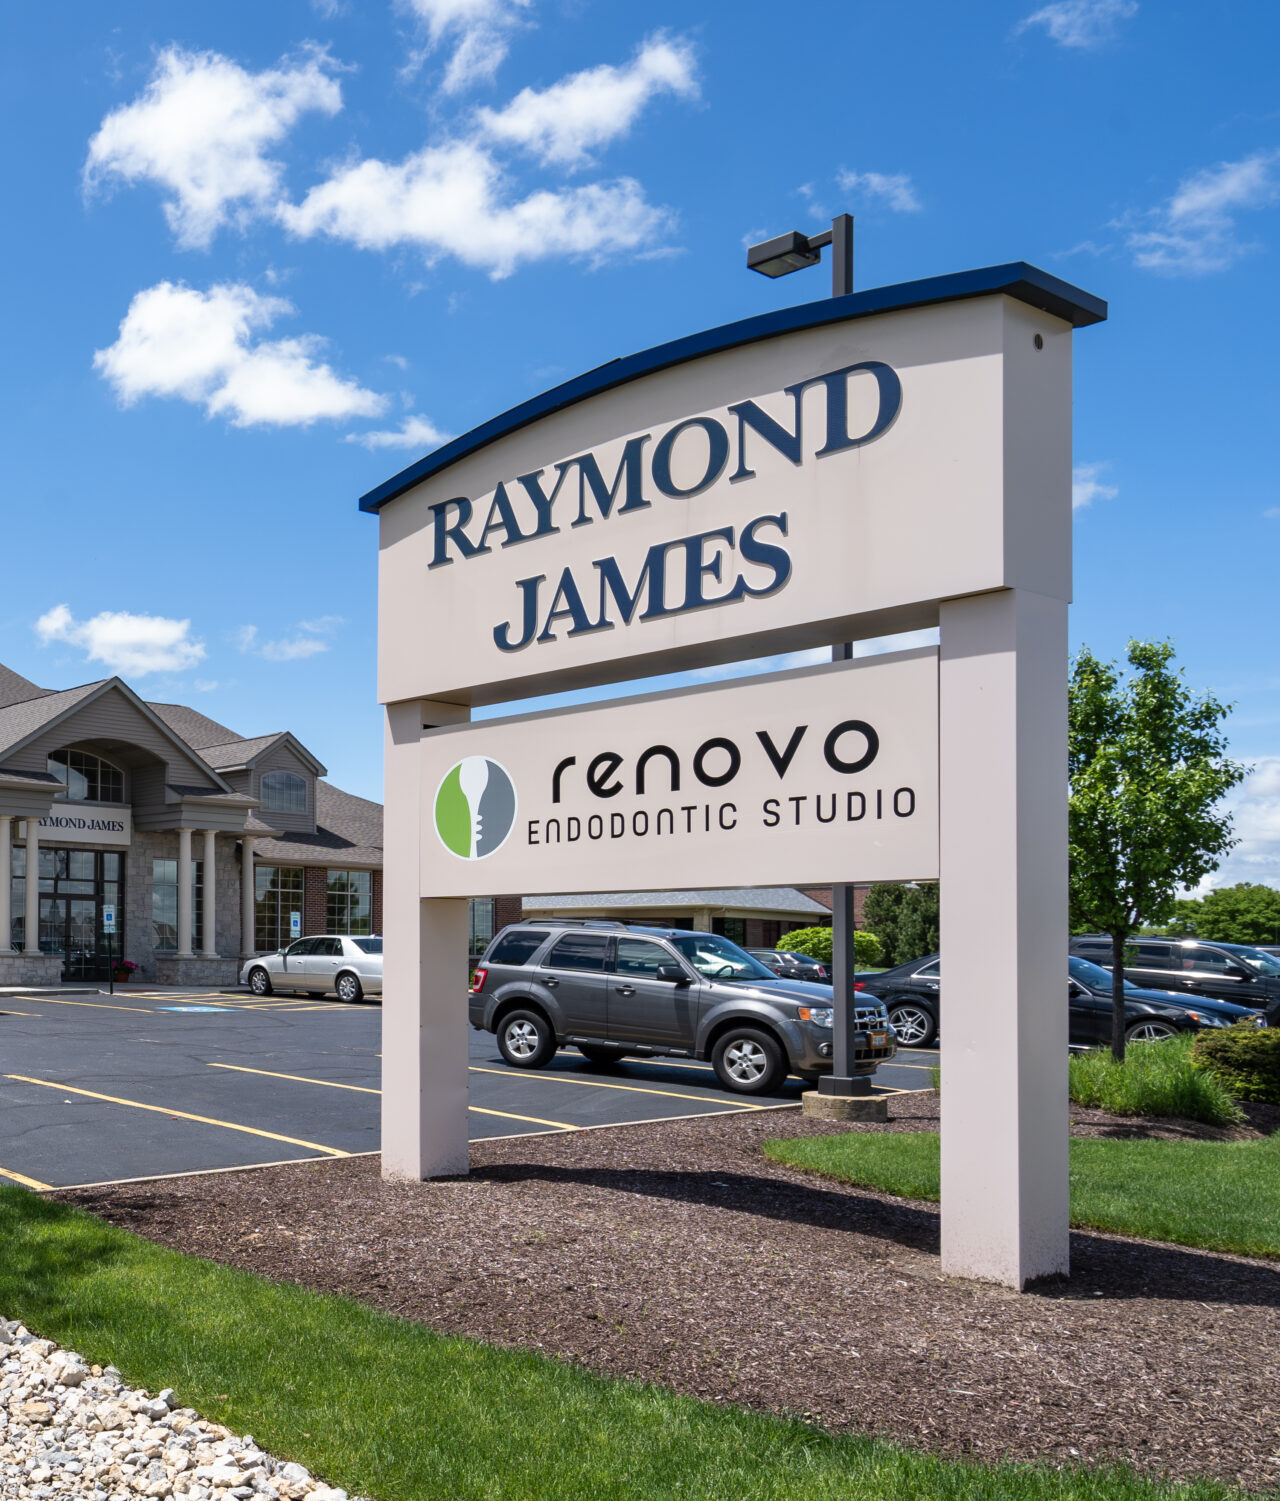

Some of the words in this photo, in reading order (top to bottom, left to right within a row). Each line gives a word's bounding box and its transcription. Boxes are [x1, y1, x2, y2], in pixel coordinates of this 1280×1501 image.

[427, 361, 903, 570] RAYMOND
[492, 511, 793, 653] JAMES
[552, 719, 880, 803] renovo
[87, 819, 124, 832] JAMES
[528, 802, 738, 845] ENDODONTIC
[762, 787, 916, 827] STUDIO
